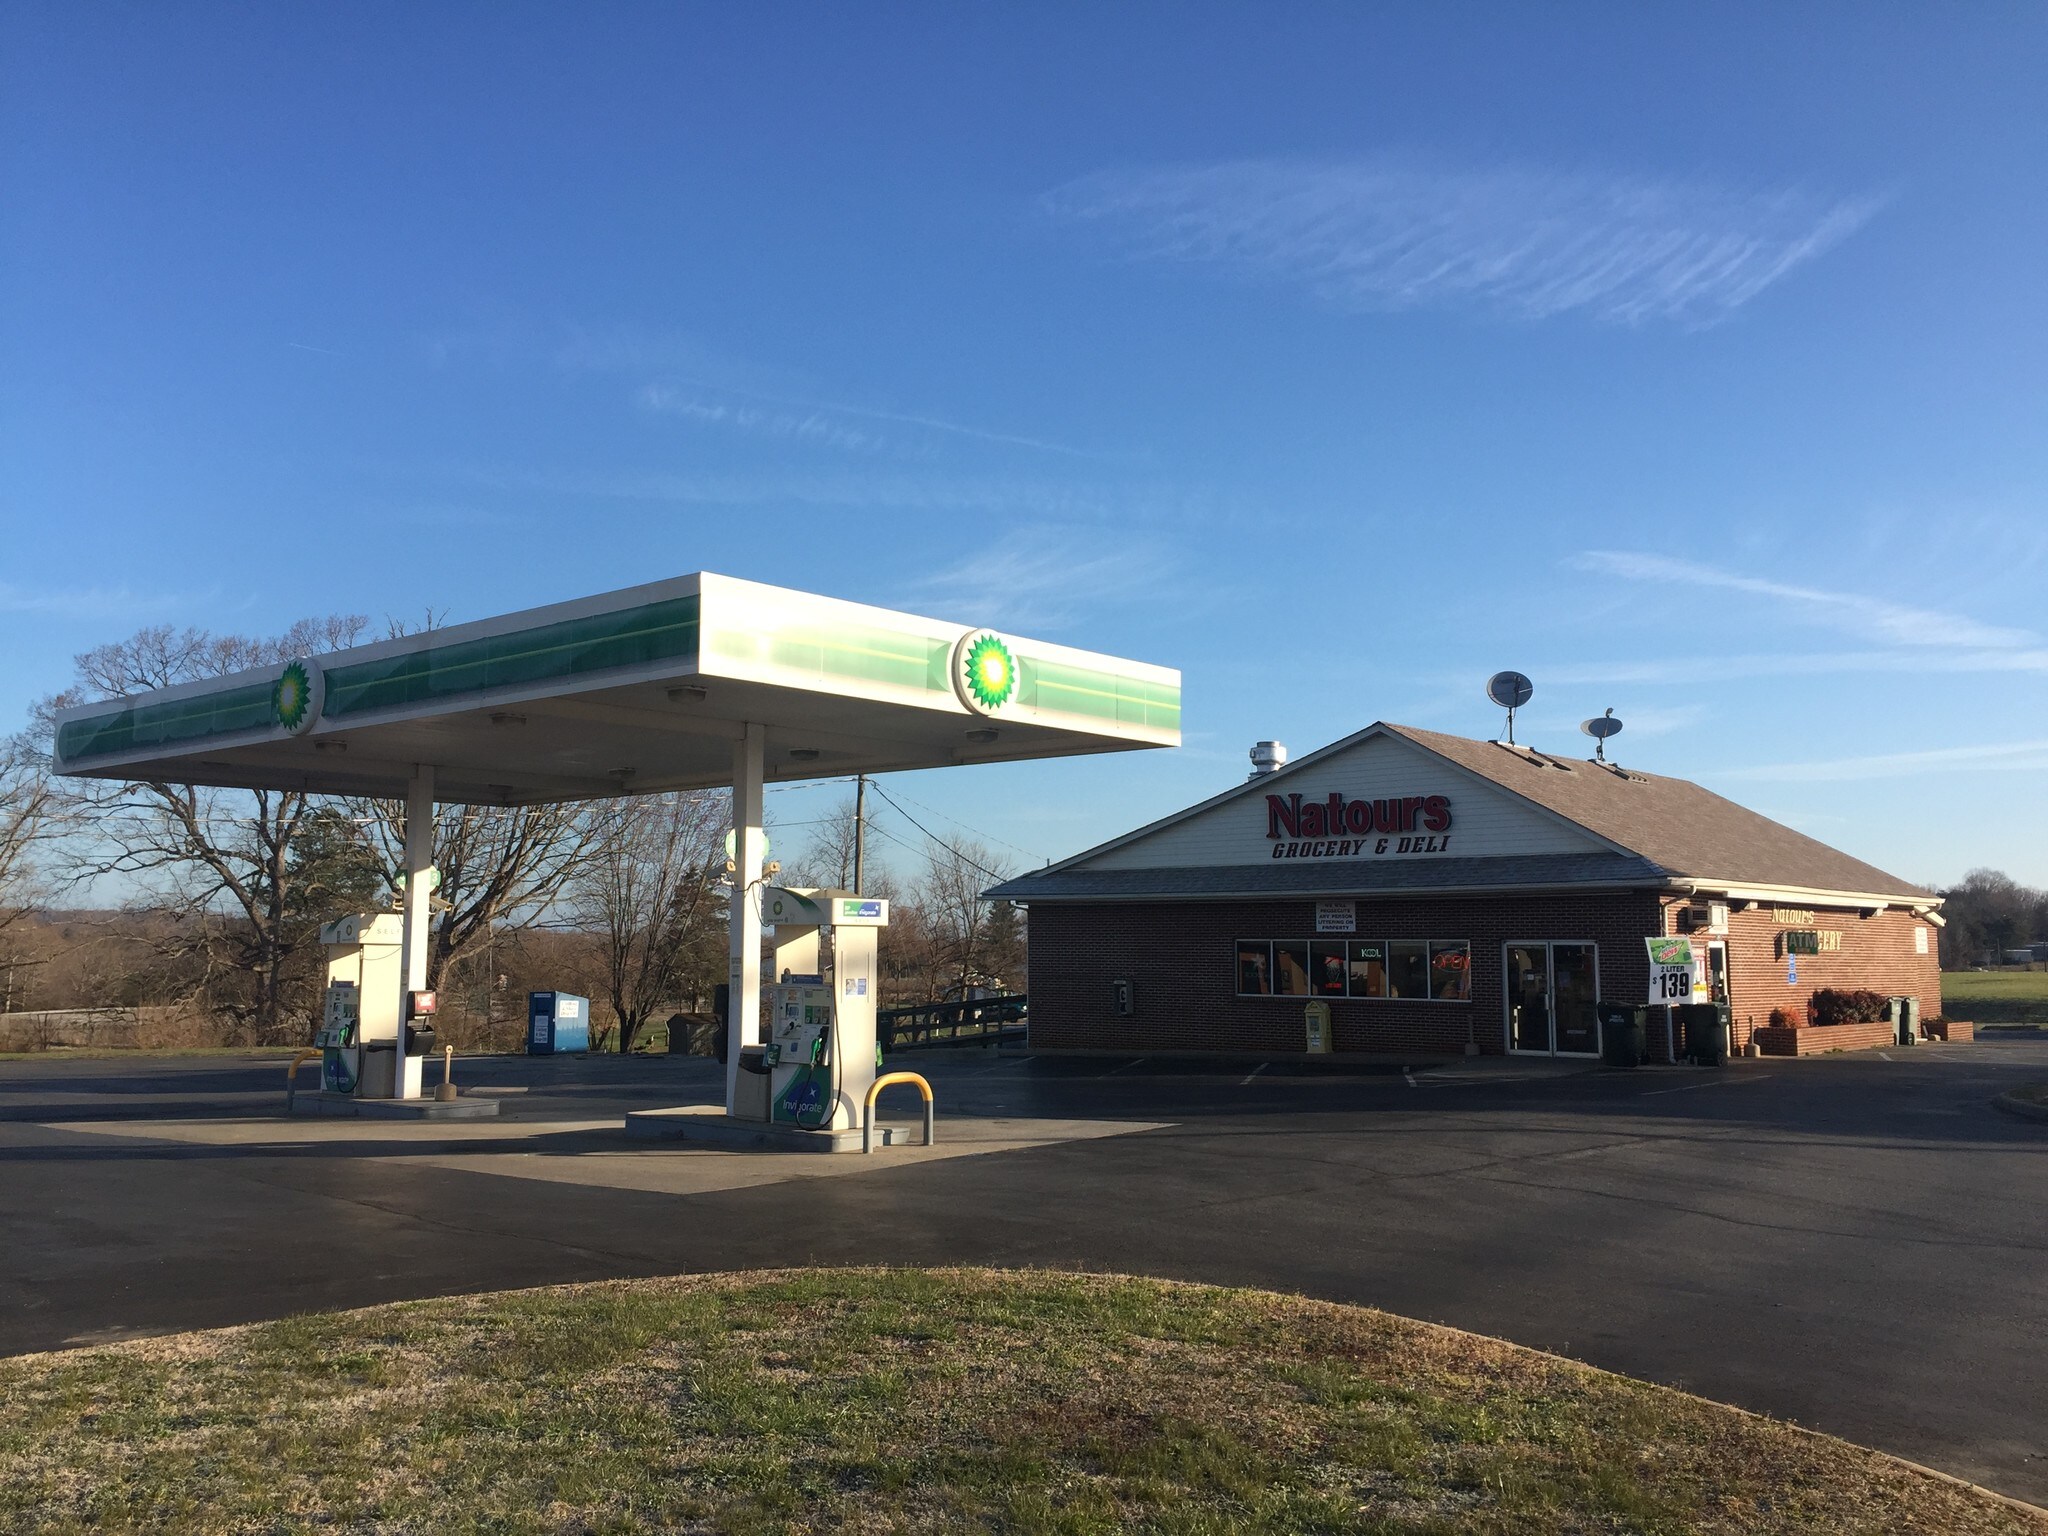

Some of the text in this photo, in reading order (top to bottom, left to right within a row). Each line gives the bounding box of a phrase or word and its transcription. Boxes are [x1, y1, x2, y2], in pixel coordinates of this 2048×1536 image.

[1265, 793, 1452, 839] Natours
[1272, 836, 1451, 859] GROCERY & DELI
[1789, 933, 1817, 948] ATM
[1361, 948, 1382, 958] KOOL
[1432, 955, 1470, 970] OPEN
